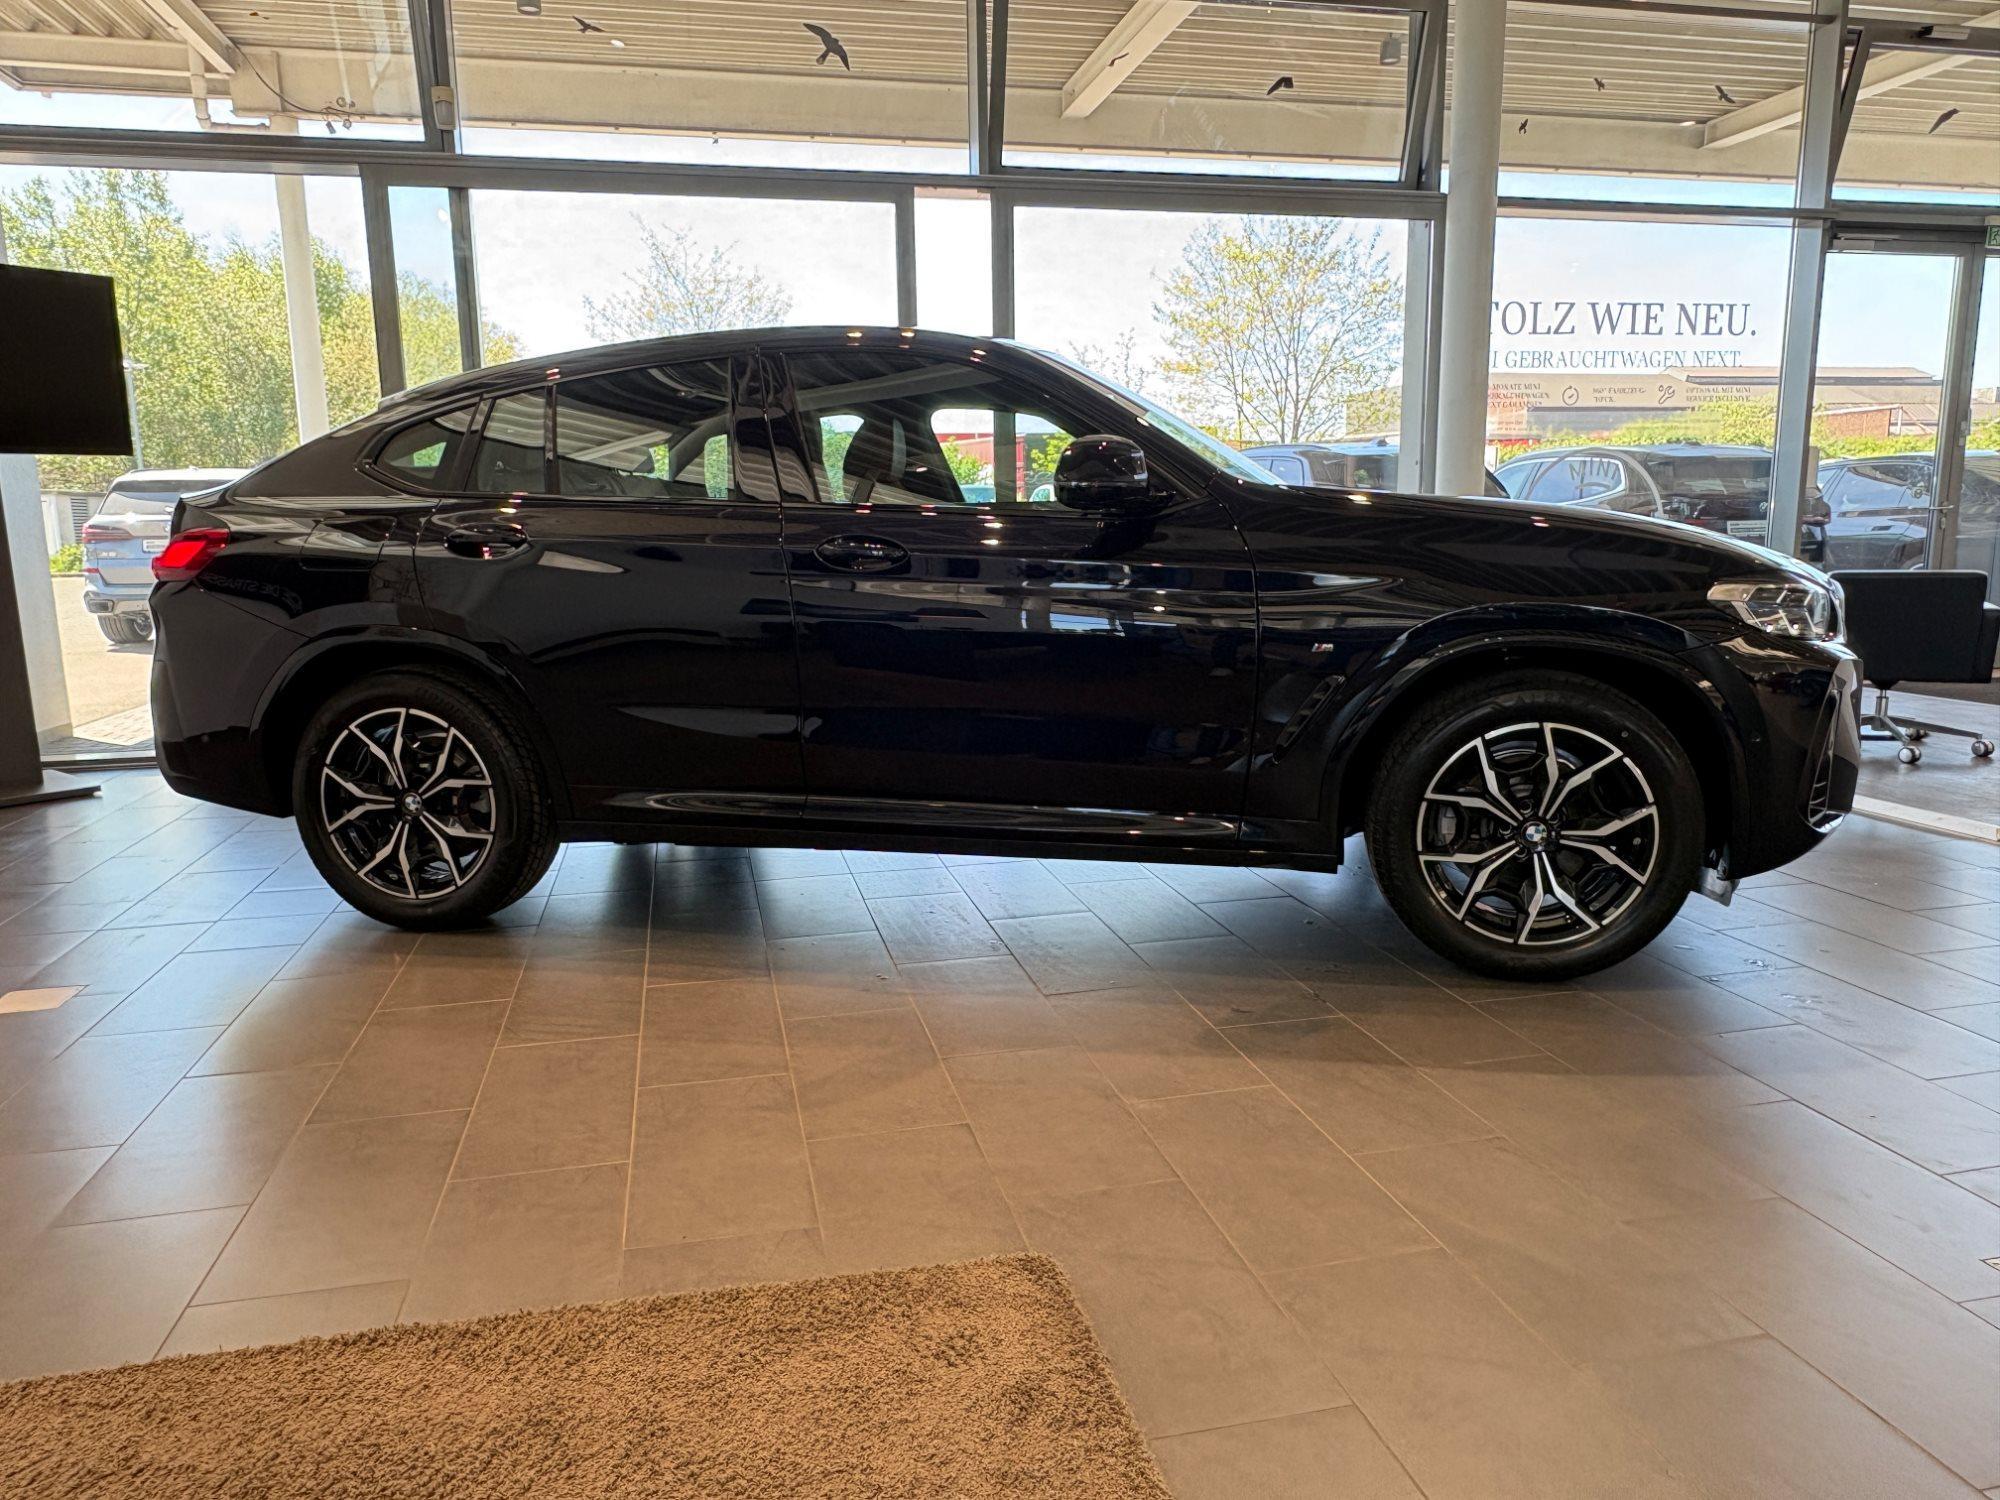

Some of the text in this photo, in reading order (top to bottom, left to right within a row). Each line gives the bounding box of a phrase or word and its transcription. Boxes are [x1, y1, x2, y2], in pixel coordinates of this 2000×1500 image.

[1587, 302, 1664, 335] WIE
[1675, 303, 1756, 336] NEU.
[1505, 350, 1685, 369] GEBRAUCHTWAGEN
[1692, 351, 1743, 368] NEXT.
